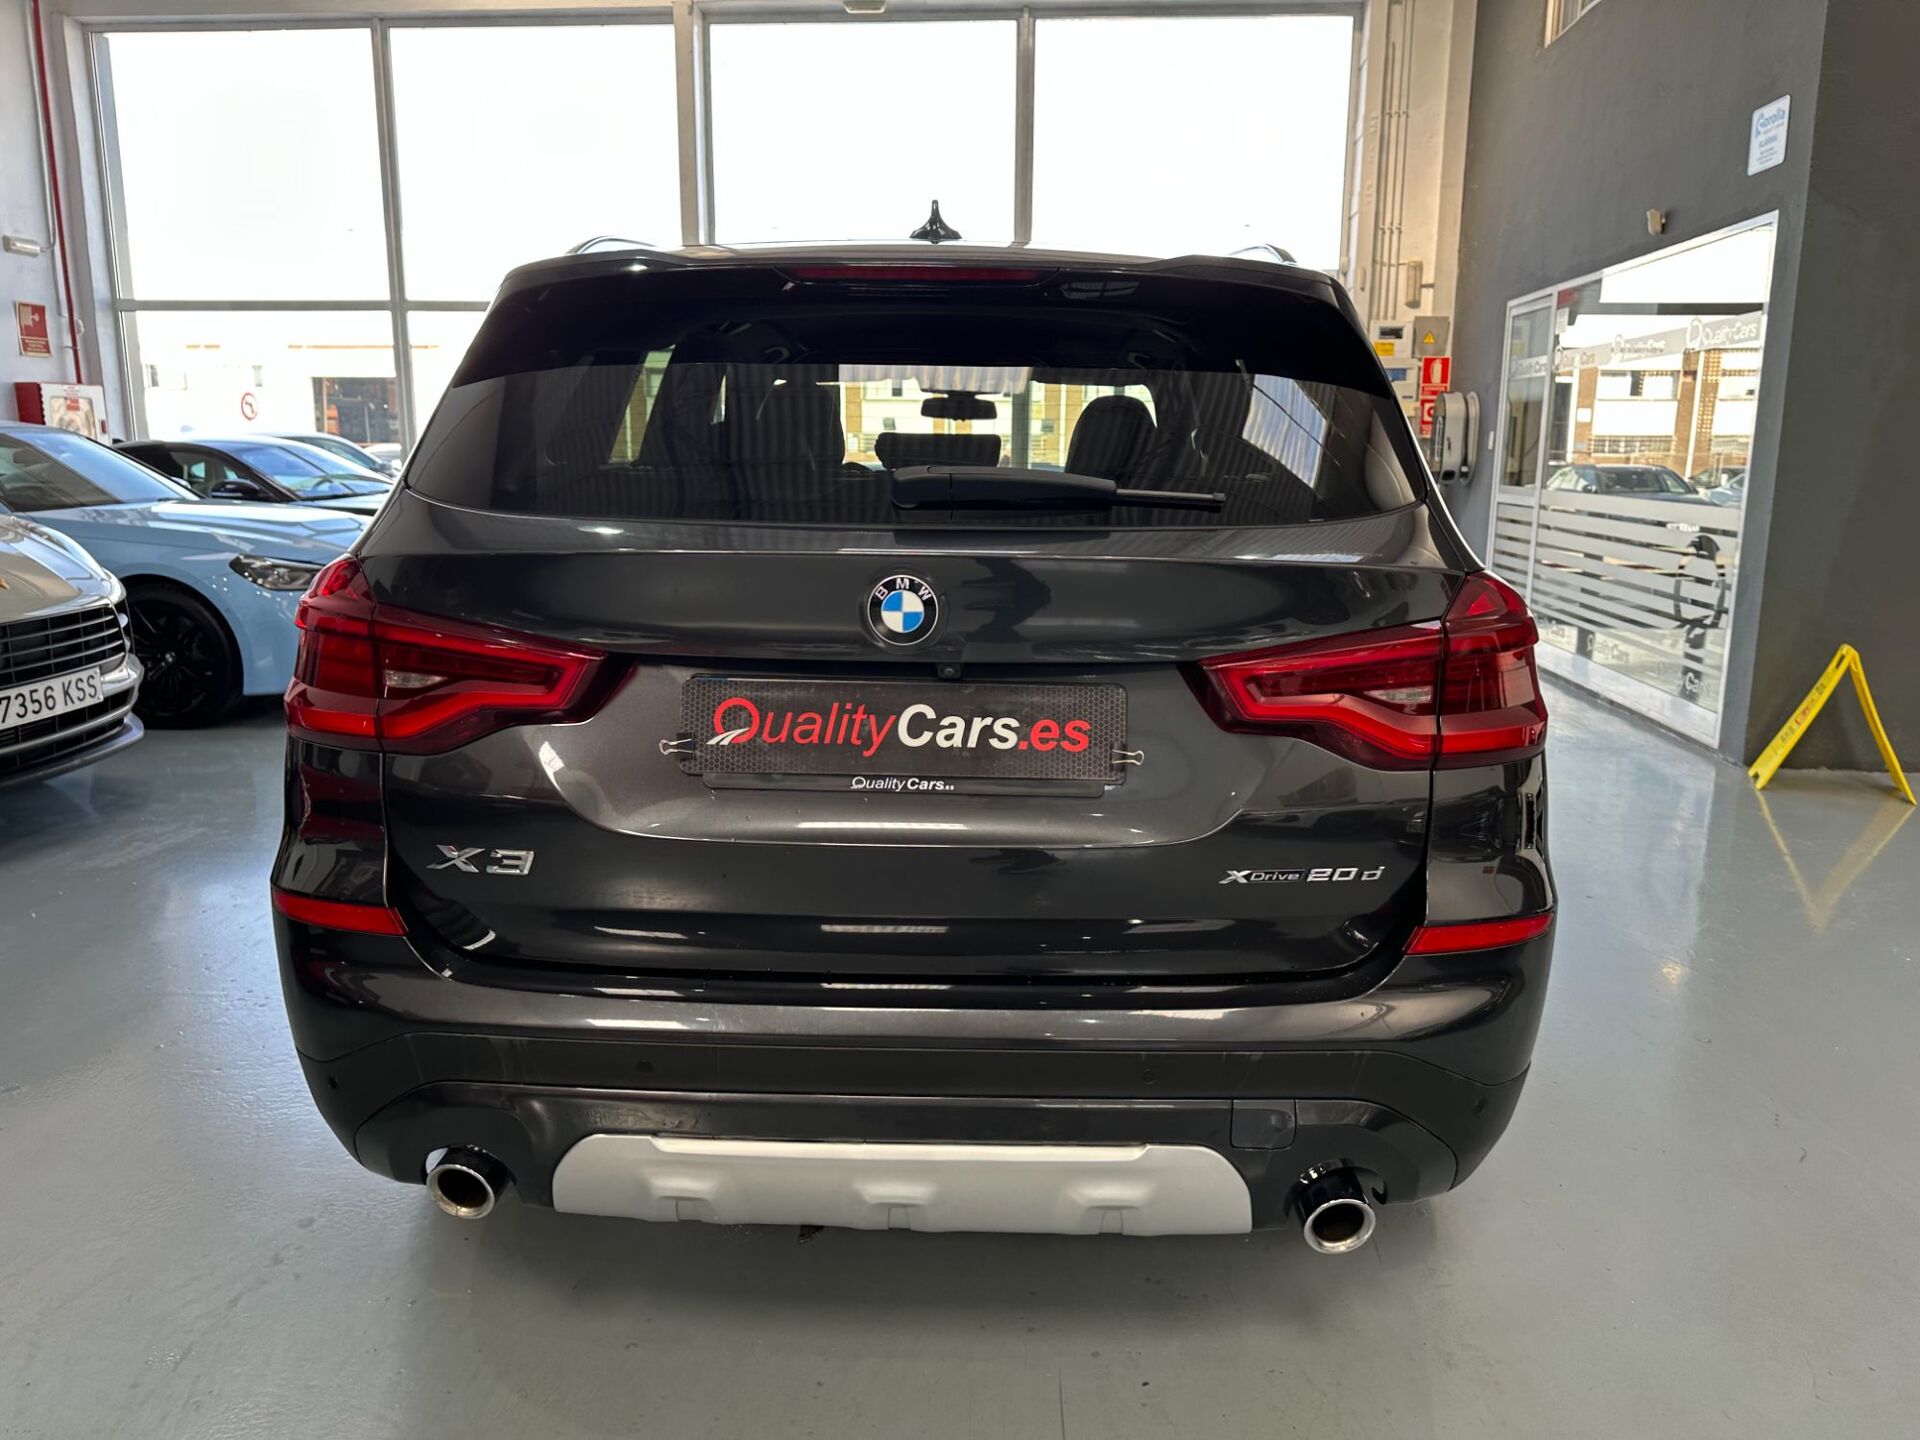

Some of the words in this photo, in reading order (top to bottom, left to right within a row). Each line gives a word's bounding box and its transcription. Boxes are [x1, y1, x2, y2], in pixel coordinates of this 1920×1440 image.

[875, 577, 932, 601] BMW
[0, 686, 56, 723] 7356
[62, 674, 97, 706] KSS
[706, 698, 1091, 757] QualityCars.es
[425, 844, 535, 875] X3
